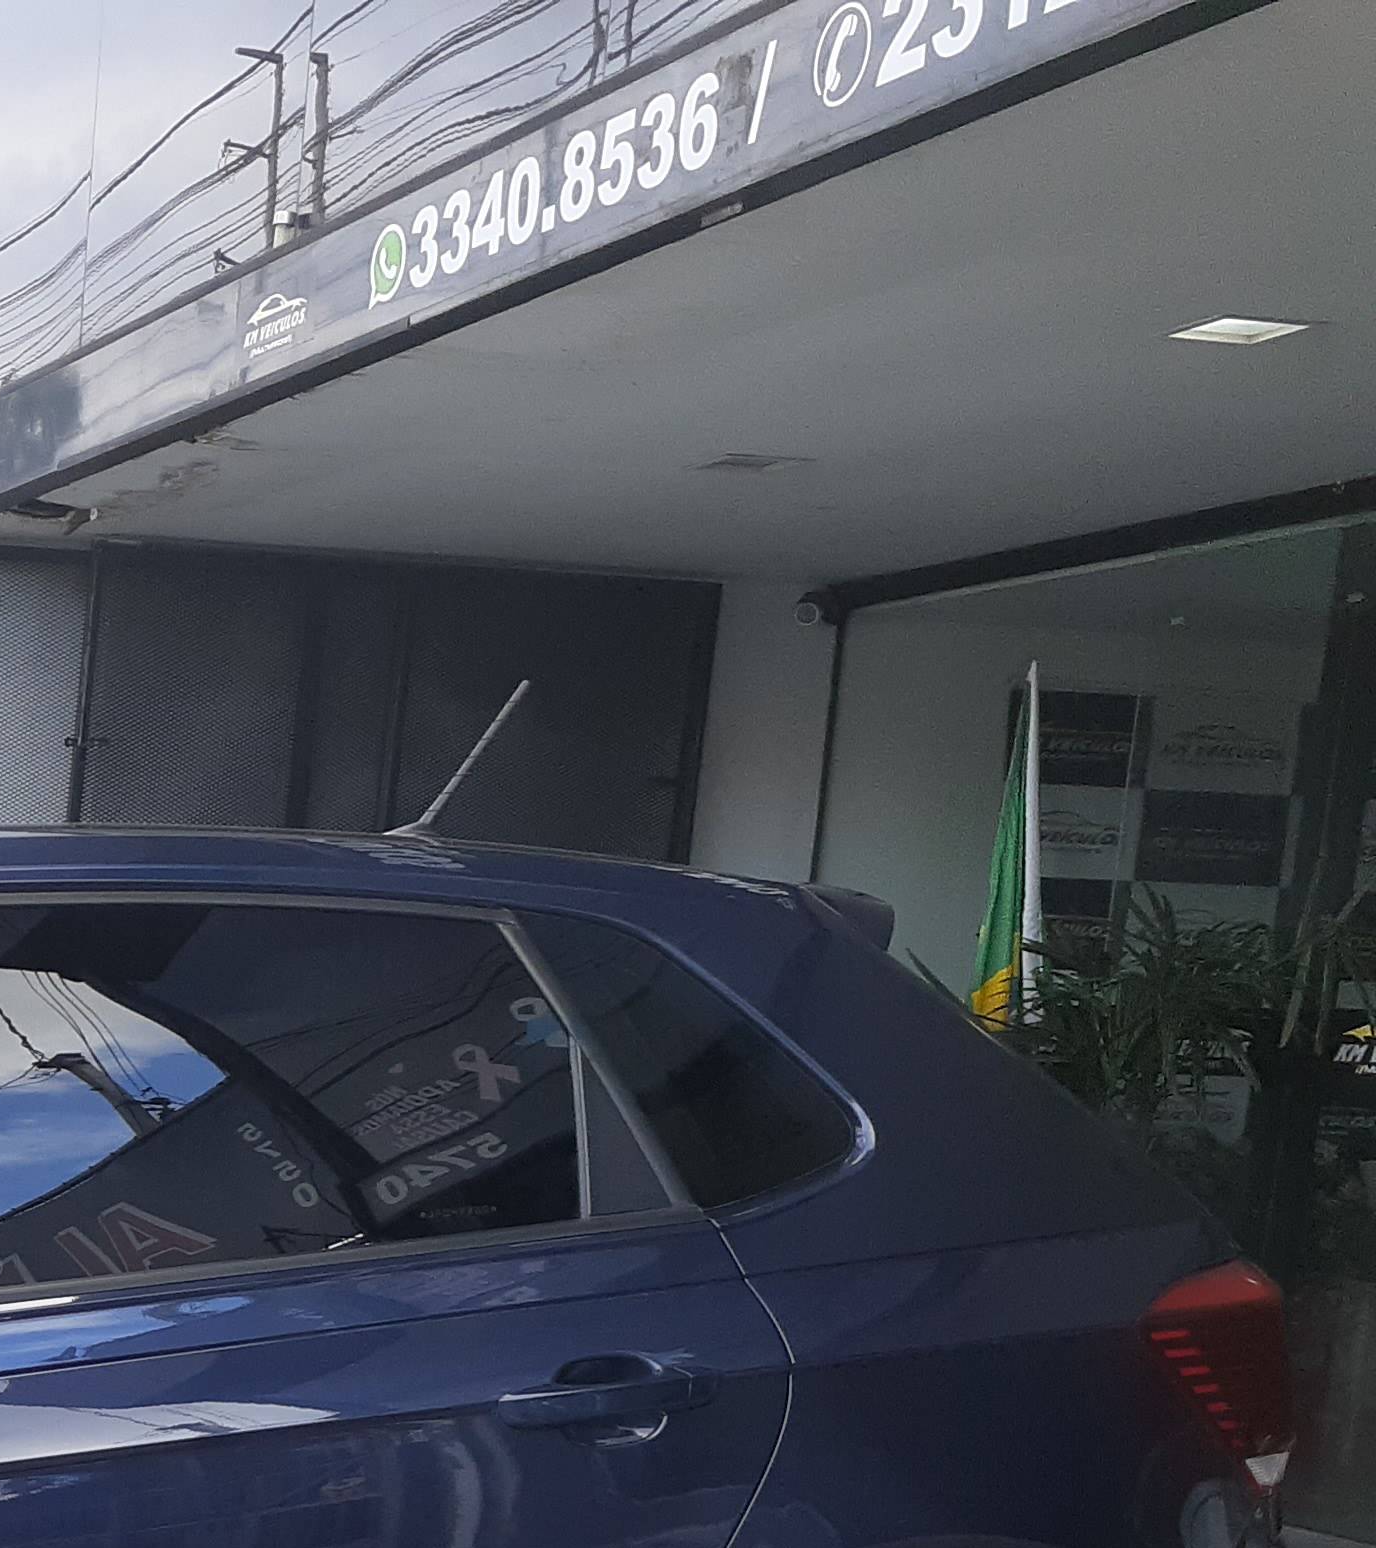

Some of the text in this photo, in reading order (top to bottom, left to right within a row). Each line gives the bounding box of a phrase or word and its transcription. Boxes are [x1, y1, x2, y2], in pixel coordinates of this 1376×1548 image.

[408, 72, 720, 288] 3340.8536
[259, 307, 307, 342] VEICULOS
[1333, 1044, 1368, 1062] KM
